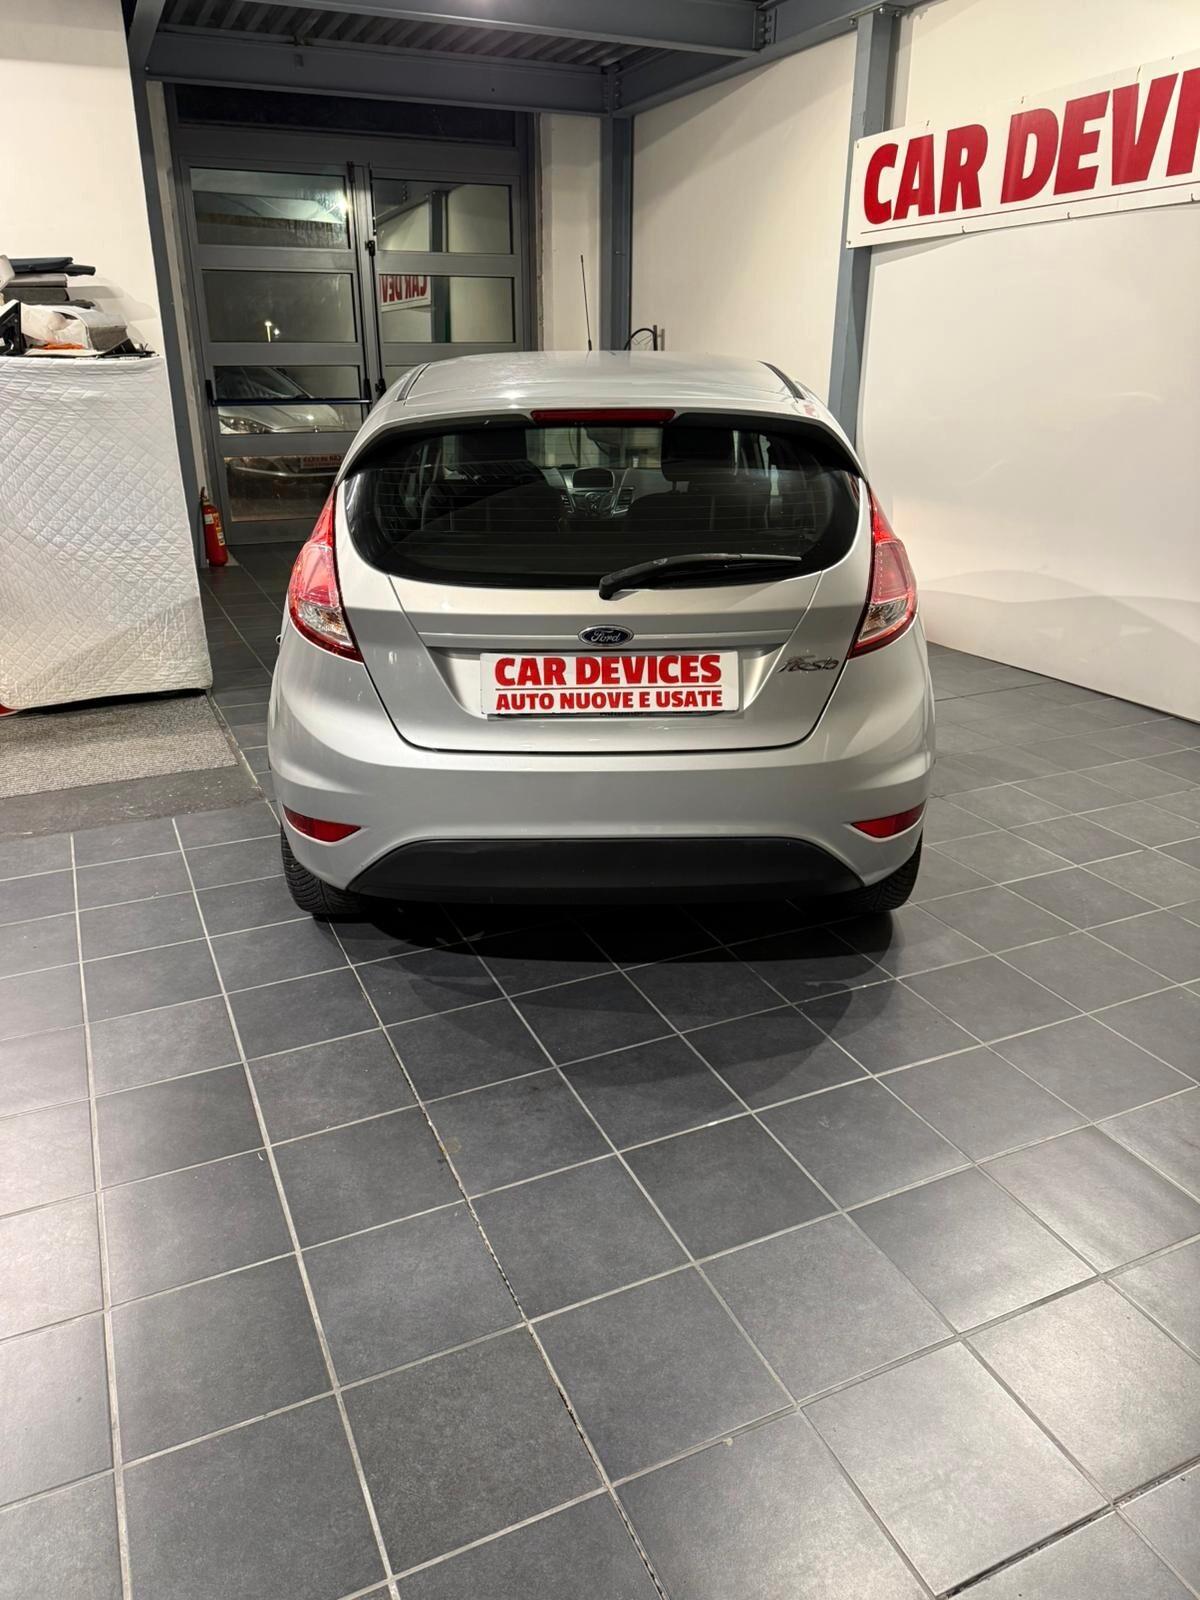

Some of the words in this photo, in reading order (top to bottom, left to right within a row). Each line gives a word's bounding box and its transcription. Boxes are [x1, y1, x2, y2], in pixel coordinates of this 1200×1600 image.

[864, 124, 988, 225] CAR
[1000, 66, 1200, 204] DEVI
[591, 629, 622, 642] Ford
[495, 657, 567, 687] CAR
[575, 655, 722, 685] DEVICES
[496, 693, 555, 710] AUTO
[560, 692, 634, 709] NUOVE
[639, 692, 651, 708] E
[656, 690, 722, 708] USATE
